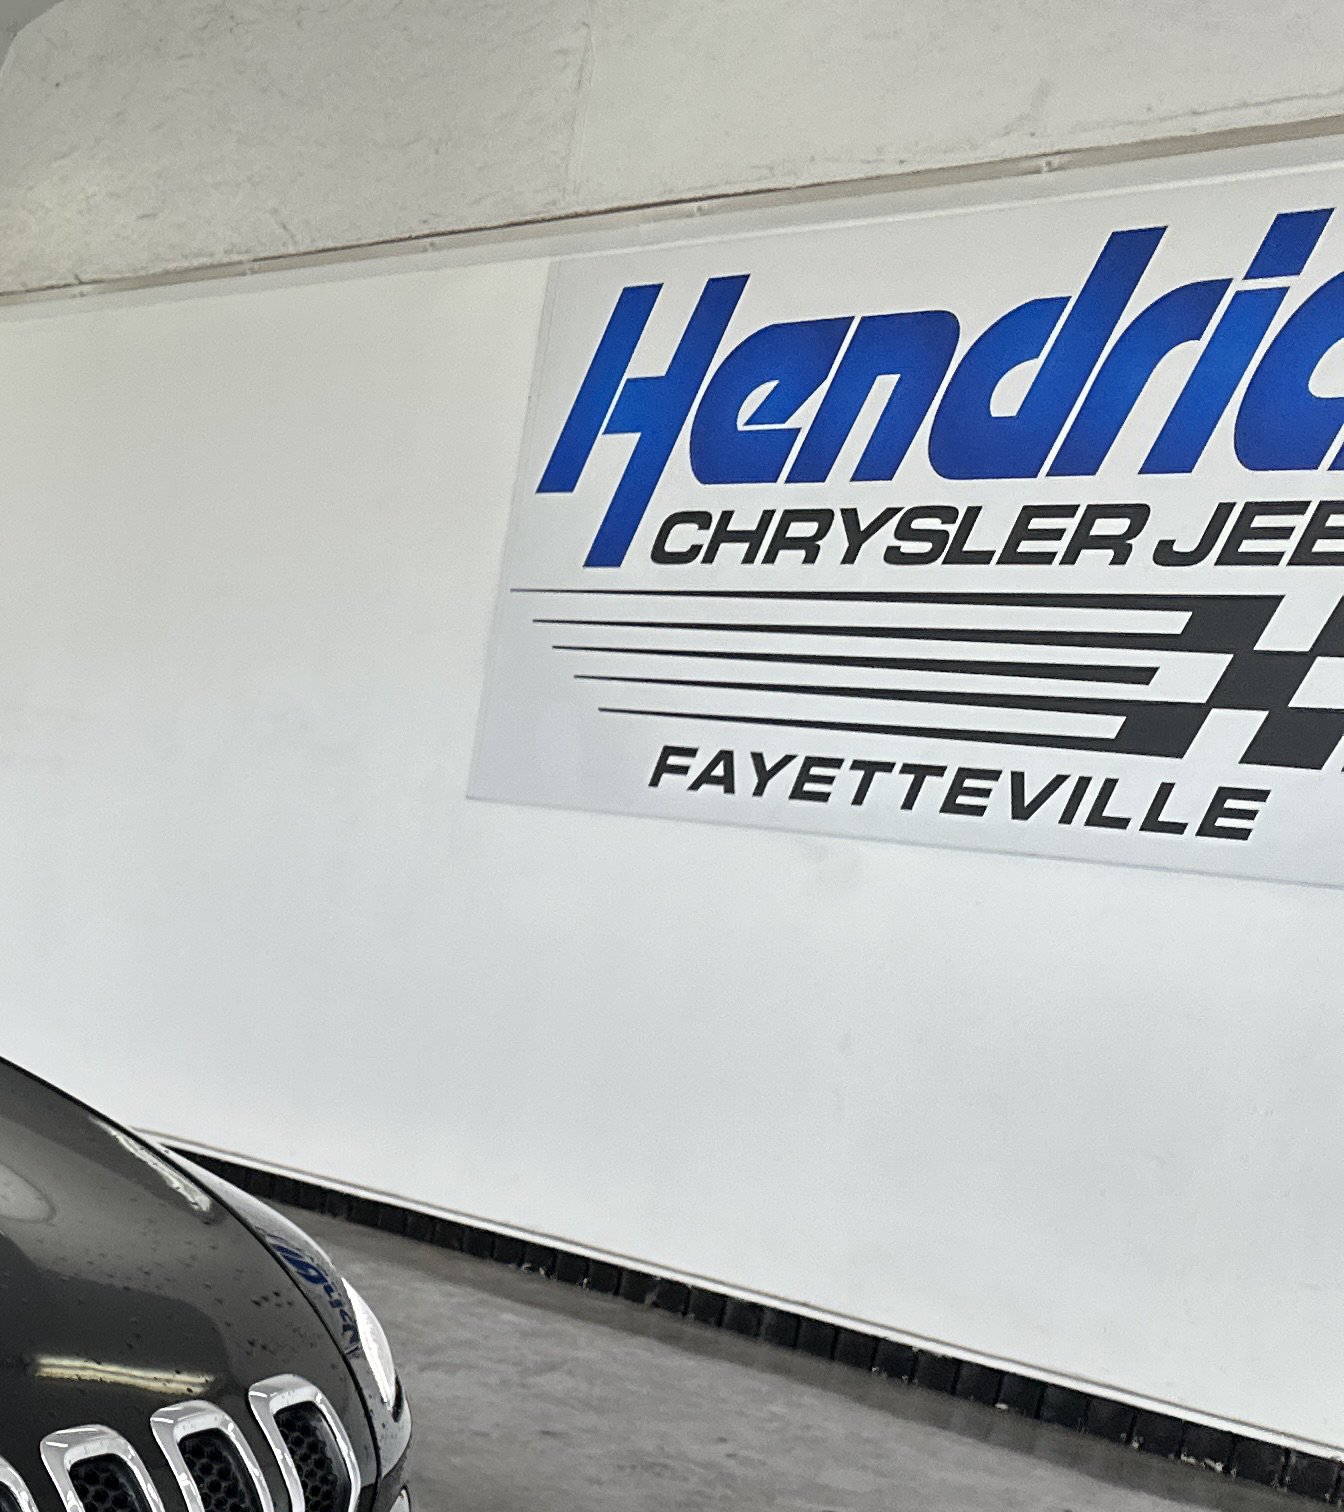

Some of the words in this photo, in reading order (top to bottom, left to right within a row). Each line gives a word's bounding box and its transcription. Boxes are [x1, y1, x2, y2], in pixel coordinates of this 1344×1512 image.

[536, 208, 1344, 568] Hendric
[650, 502, 1151, 568] CHRYSLER
[648, 744, 1271, 842] FAYETTEVILLE
